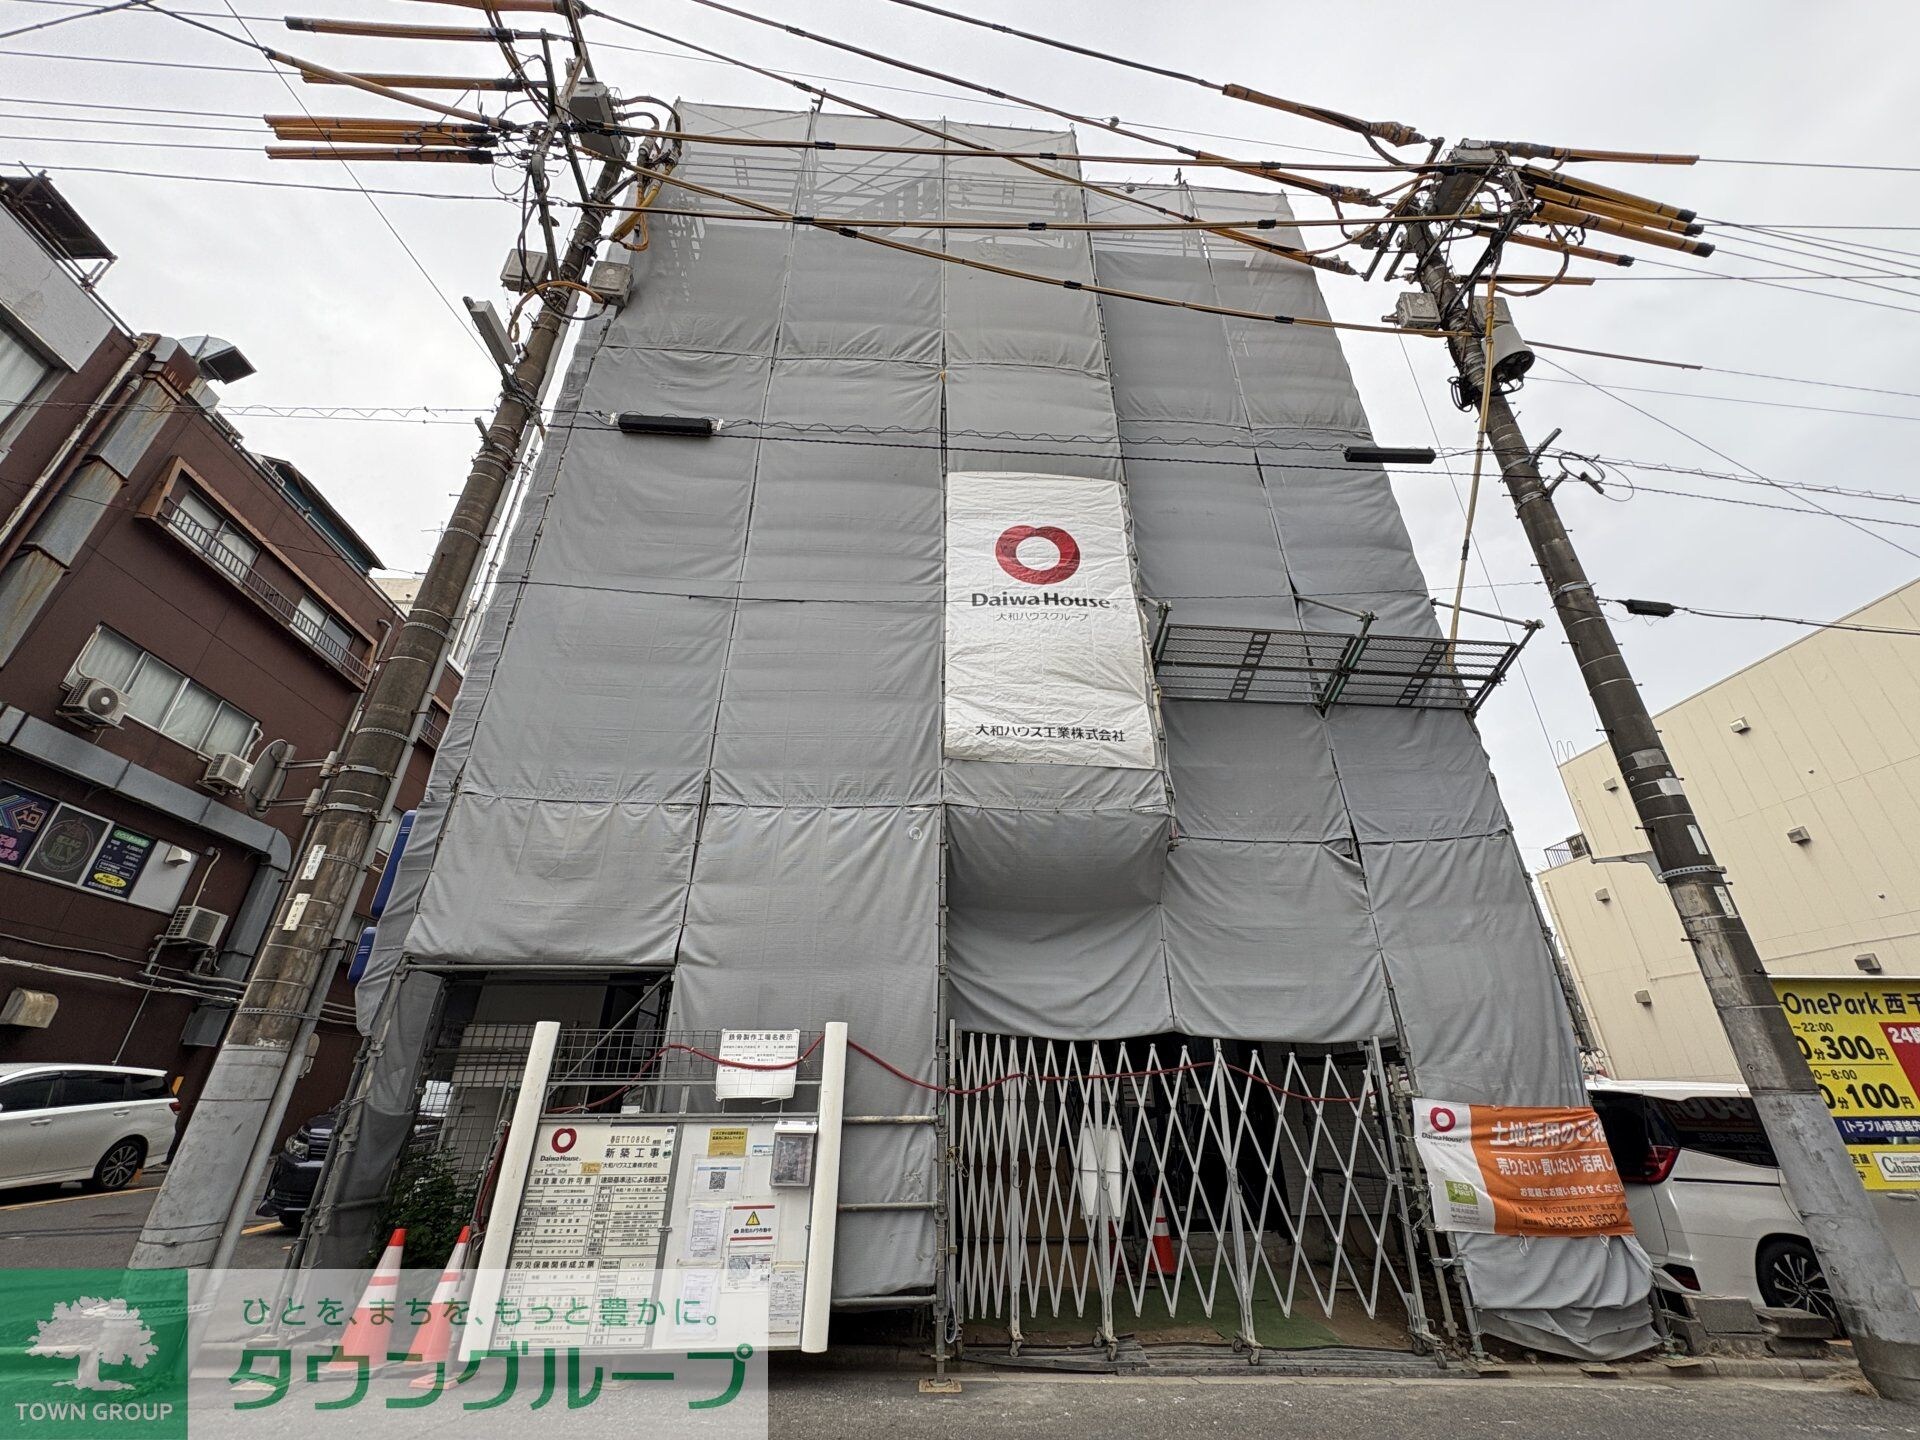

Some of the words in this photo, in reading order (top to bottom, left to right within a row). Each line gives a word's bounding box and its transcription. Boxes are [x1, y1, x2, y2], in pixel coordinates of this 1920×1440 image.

[996, 612, 1089, 622] 大和ハウスグループ
[975, 724, 1126, 742] 大和ハウス工業株式会社
[1782, 991, 1882, 1015] OnePark
[728, 1033, 793, 1041] 鉄骨製作工場名表示
[1812, 1070, 1857, 1080] 0~8:00
[604, 1147, 660, 1158] 新築工事
[534, 1177, 592, 1185] 建設業の許可票
[515, 1260, 595, 1269] 労災保険関係成立票
